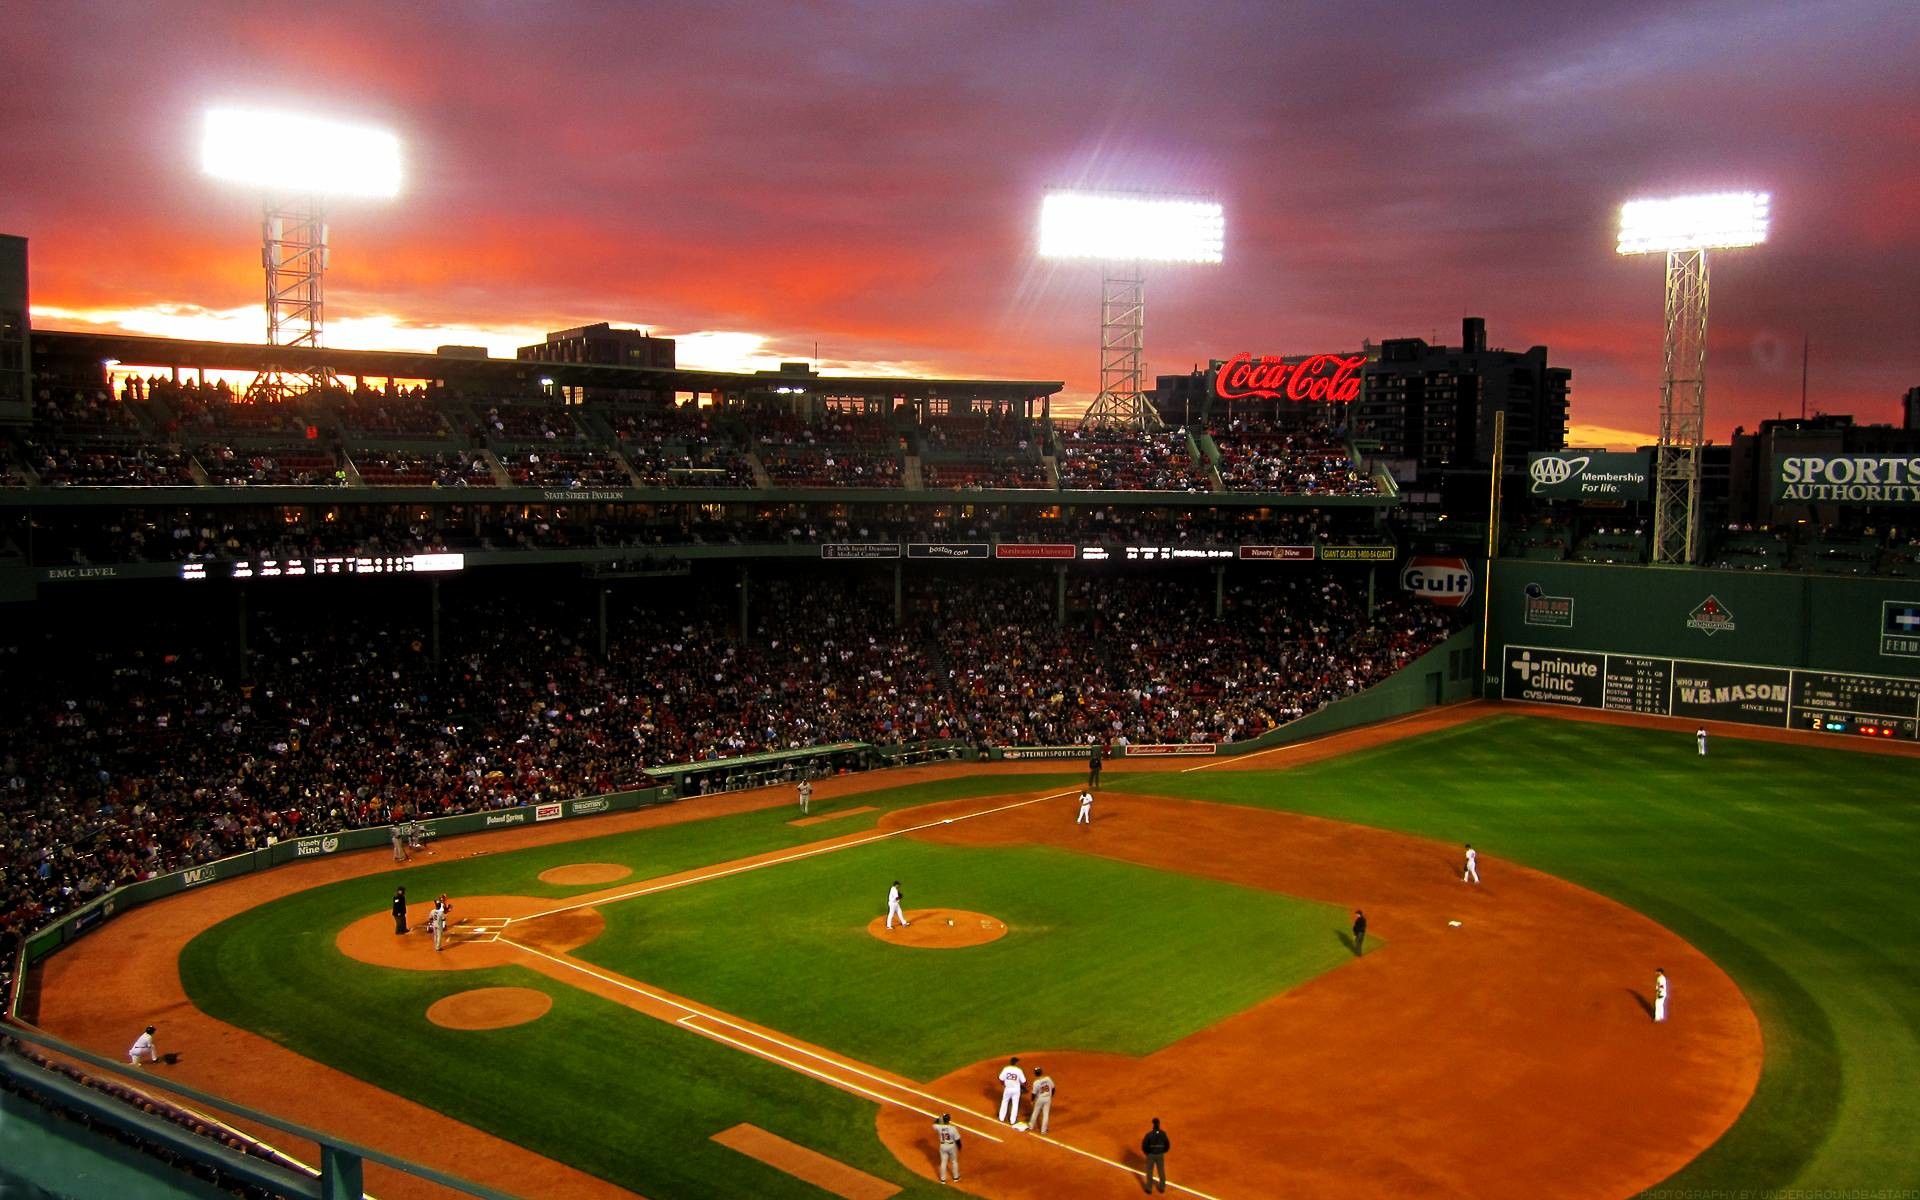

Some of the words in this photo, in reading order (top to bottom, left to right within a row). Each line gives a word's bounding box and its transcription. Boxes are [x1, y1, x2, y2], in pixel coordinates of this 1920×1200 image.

[1534, 458, 1567, 484] AAA
[1781, 457, 1920, 484] SPORTS
[1581, 472, 1644, 483] Membership
[1581, 483, 1599, 492] For
[1781, 484, 1920, 501] AUTHORITY
[565, 491, 590, 500] STREET
[591, 491, 623, 499] PAVILION
[1324, 550, 1340, 558] GIANT
[1376, 550, 1392, 558] GIANT
[48, 569, 76, 578] EMC
[79, 567, 117, 577] LEVEL
[1405, 570, 1468, 592] Gulf
[1541, 658, 1598, 677] minute
[1531, 673, 1575, 692] clinic
[1675, 679, 1693, 687] WHO
[1823, 676, 1875, 686] FENWAY
[1522, 690, 1582, 704] CVS/pharmacy
[1741, 703, 1764, 712] SINCE
[1812, 719, 1821, 730] 2
[1829, 714, 1847, 722] BALL
[1855, 717, 1879, 725] STRIKE
[486, 816, 506, 825] Poland
[506, 814, 524, 823] Spring
[297, 840, 321, 849] Ninety
[298, 846, 320, 856] Nine
